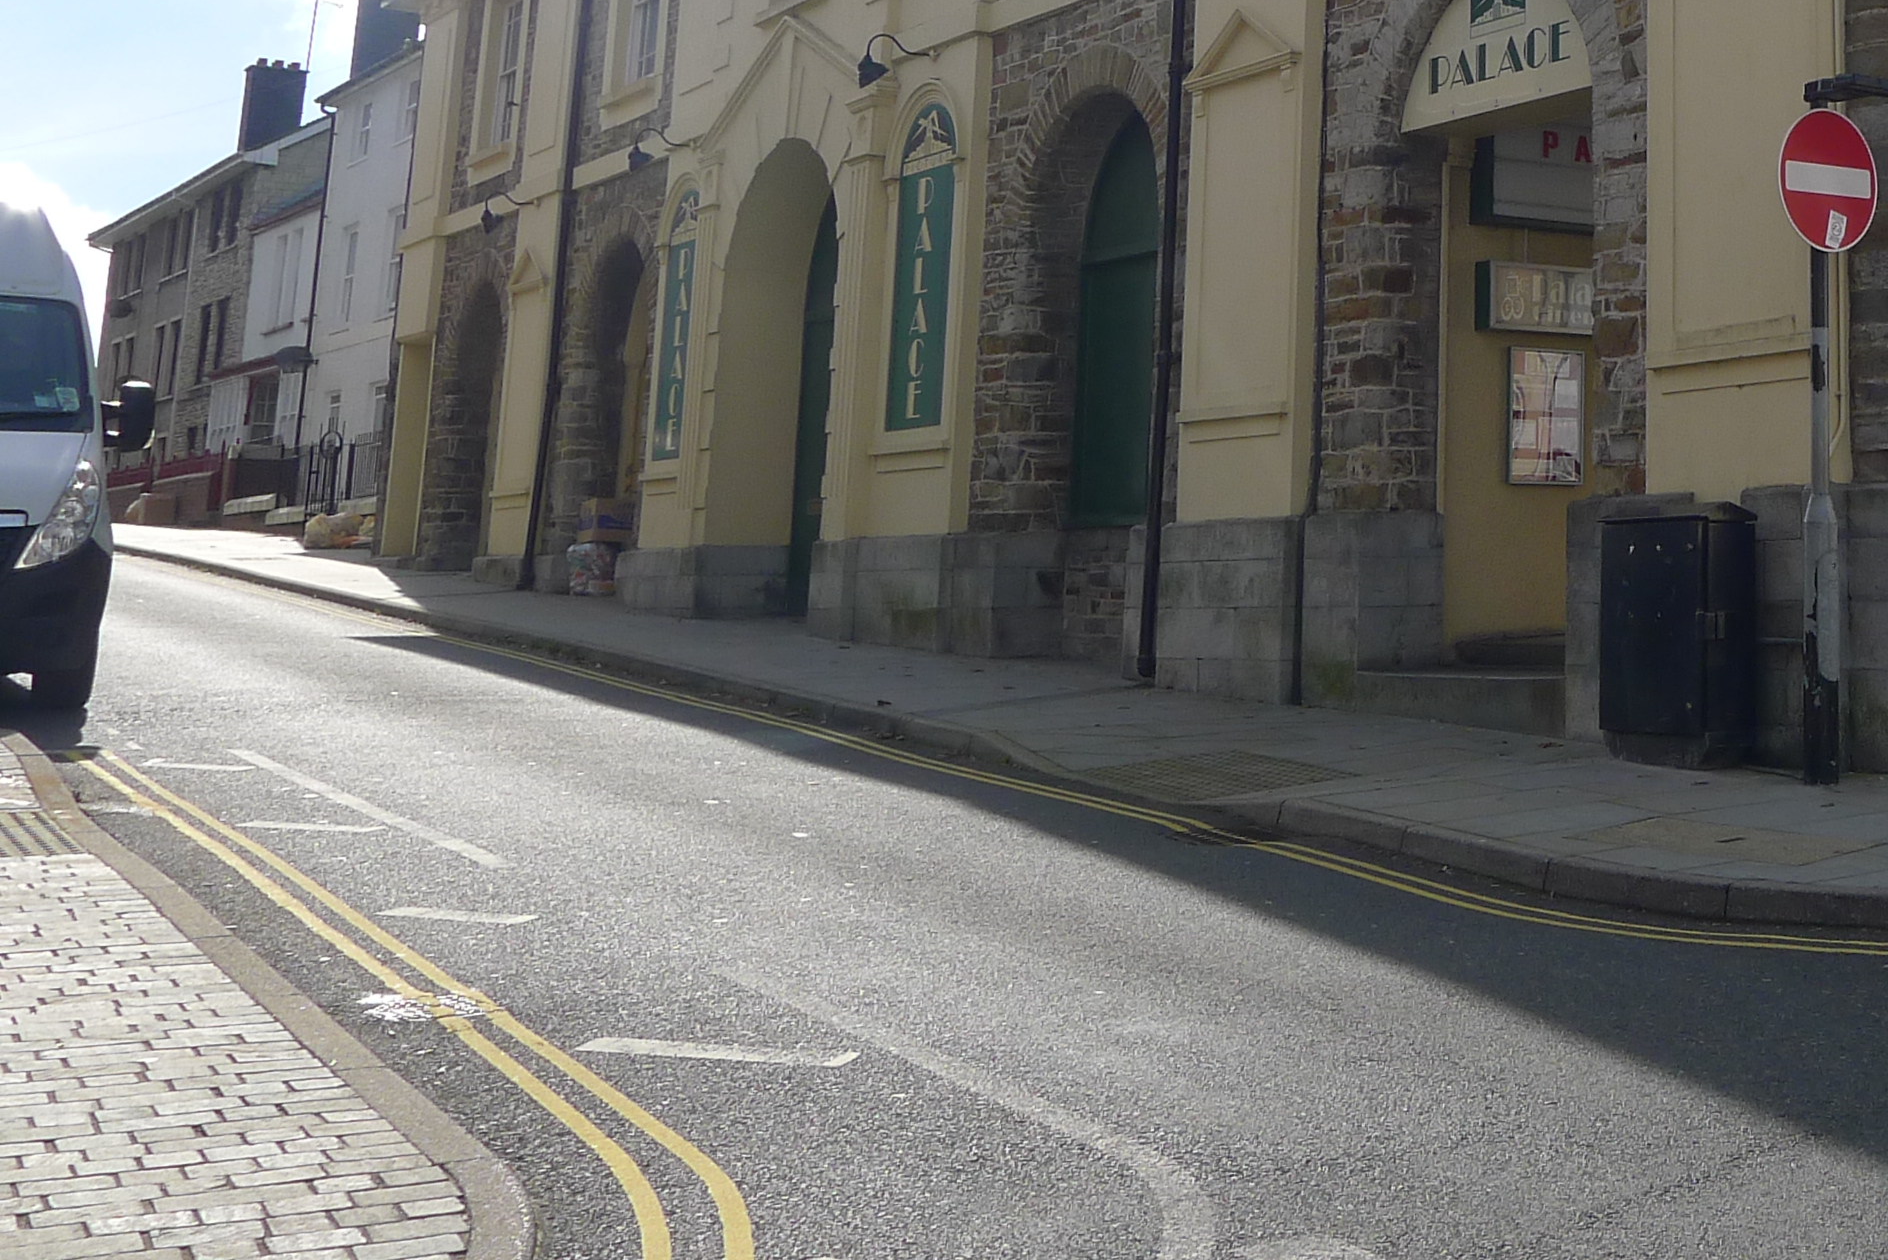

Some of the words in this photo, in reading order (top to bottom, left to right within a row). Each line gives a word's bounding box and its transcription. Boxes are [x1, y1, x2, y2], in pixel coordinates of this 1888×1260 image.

[1428, 19, 1572, 96] PALACE
[664, 246, 693, 453] PALACE
[904, 176, 936, 421] PALACE
[1532, 273, 1595, 307] Pala
